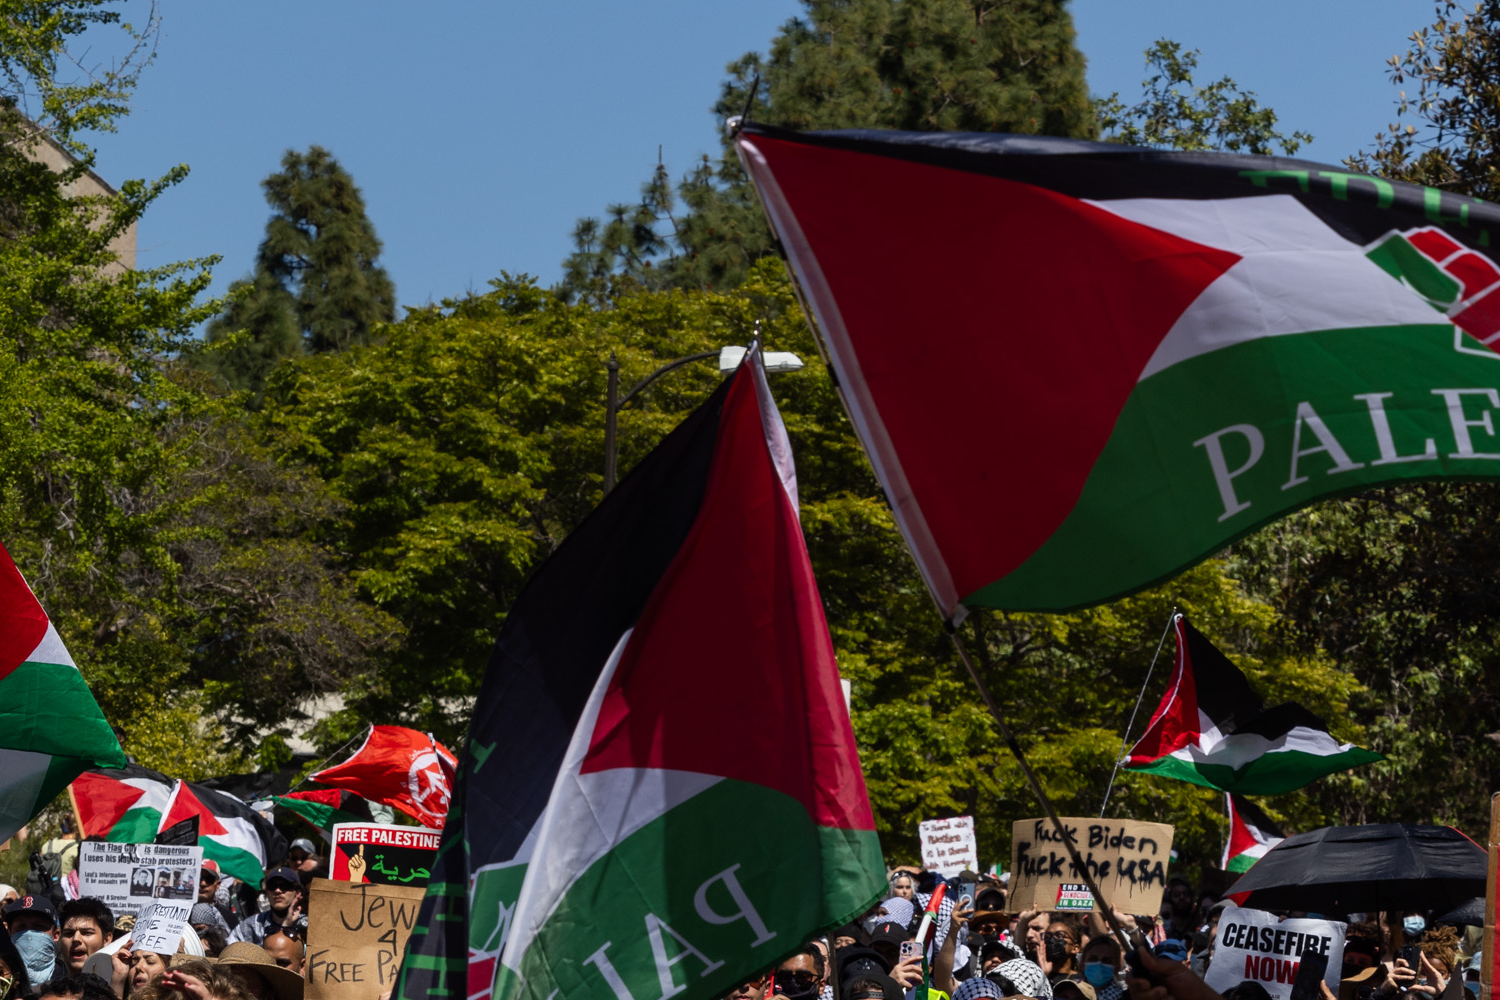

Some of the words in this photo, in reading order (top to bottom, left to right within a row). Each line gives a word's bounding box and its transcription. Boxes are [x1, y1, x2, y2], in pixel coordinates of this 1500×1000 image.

[107, 843, 123, 854] Flag
[144, 845, 151, 855] is
[154, 845, 190, 856] dangerous
[337, 828, 368, 843] FREE
[371, 830, 441, 849] PALESTINE
[1088, 825, 1157, 855] Biden
[105, 854, 117, 863] his
[140, 857, 157, 865] stab
[1017, 842, 1066, 879] Fuck
[1116, 856, 1165, 890] USA
[1071, 899, 1093, 907] GAZA
[377, 929, 398, 957] 4
[1222, 922, 1332, 957] CEASEFIRE
[308, 949, 366, 985] FREE
